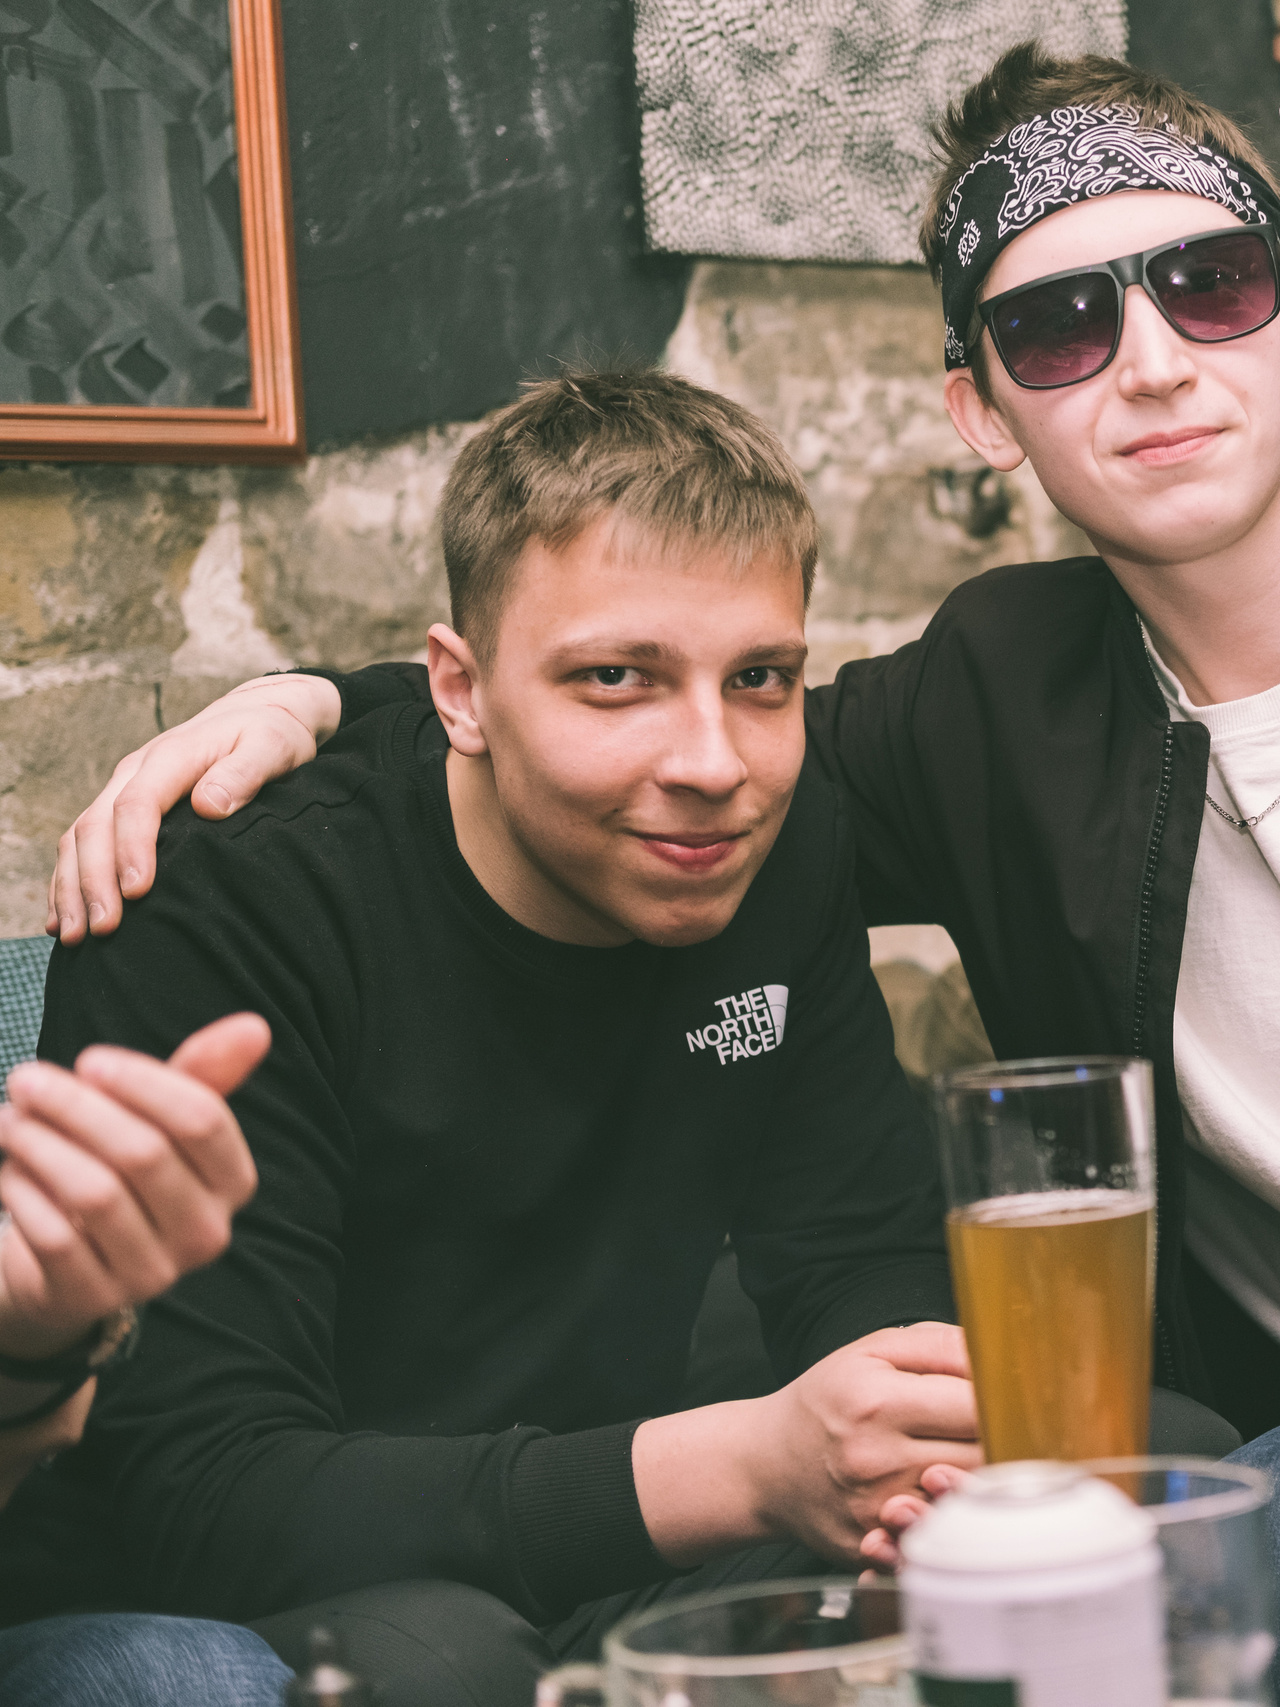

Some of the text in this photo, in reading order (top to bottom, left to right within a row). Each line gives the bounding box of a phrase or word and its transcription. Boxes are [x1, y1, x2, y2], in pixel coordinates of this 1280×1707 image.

[714, 987, 767, 1019] THE
[686, 1008, 773, 1053] NORTH
[716, 1029, 776, 1066] FACE
